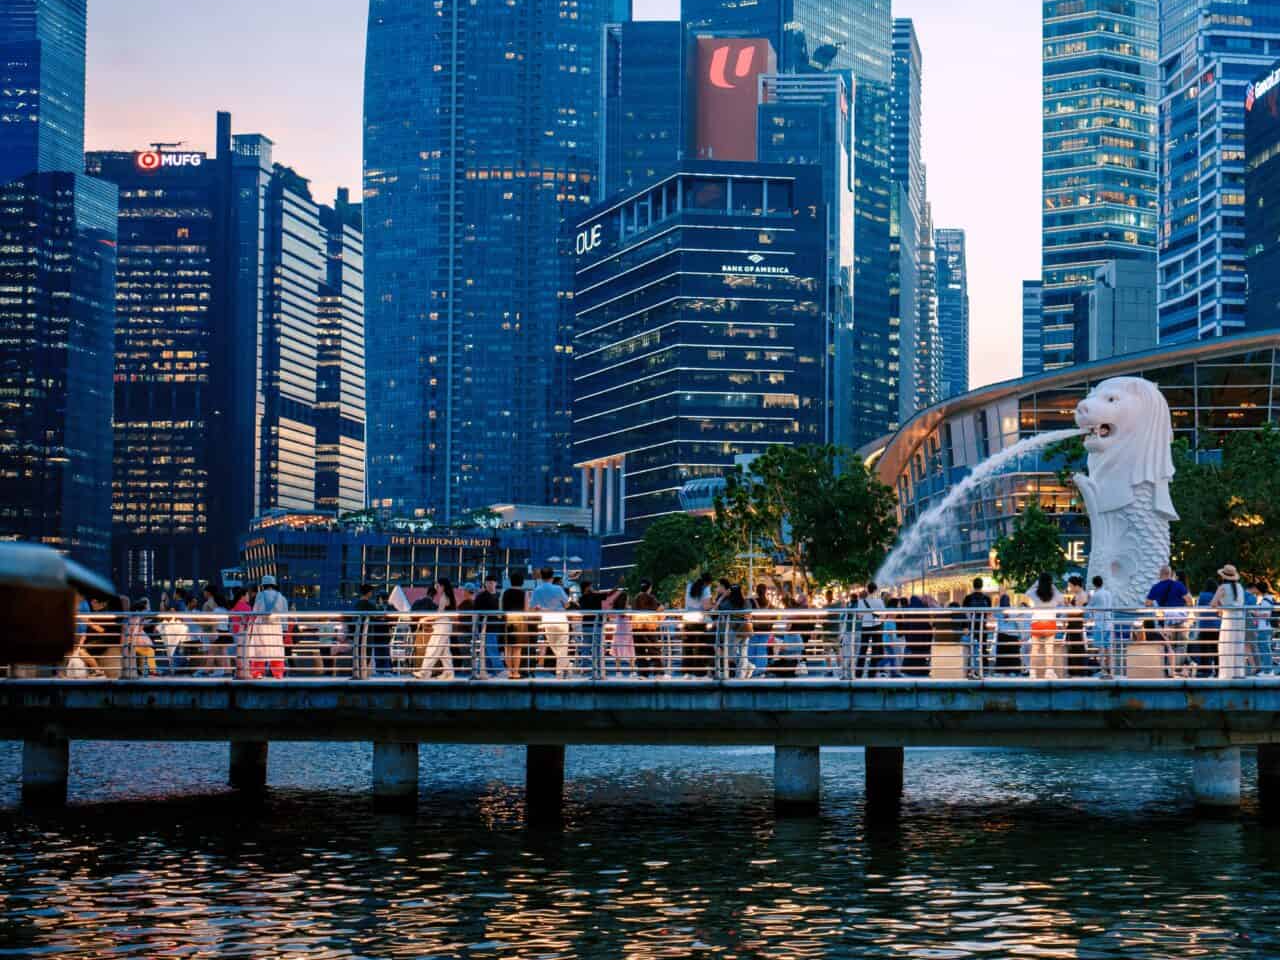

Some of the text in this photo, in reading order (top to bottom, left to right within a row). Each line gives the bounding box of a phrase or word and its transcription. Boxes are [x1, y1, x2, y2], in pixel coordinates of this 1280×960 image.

[161, 153, 201, 167] MUFG
[576, 224, 602, 255] OUE
[744, 265, 754, 273] OF
